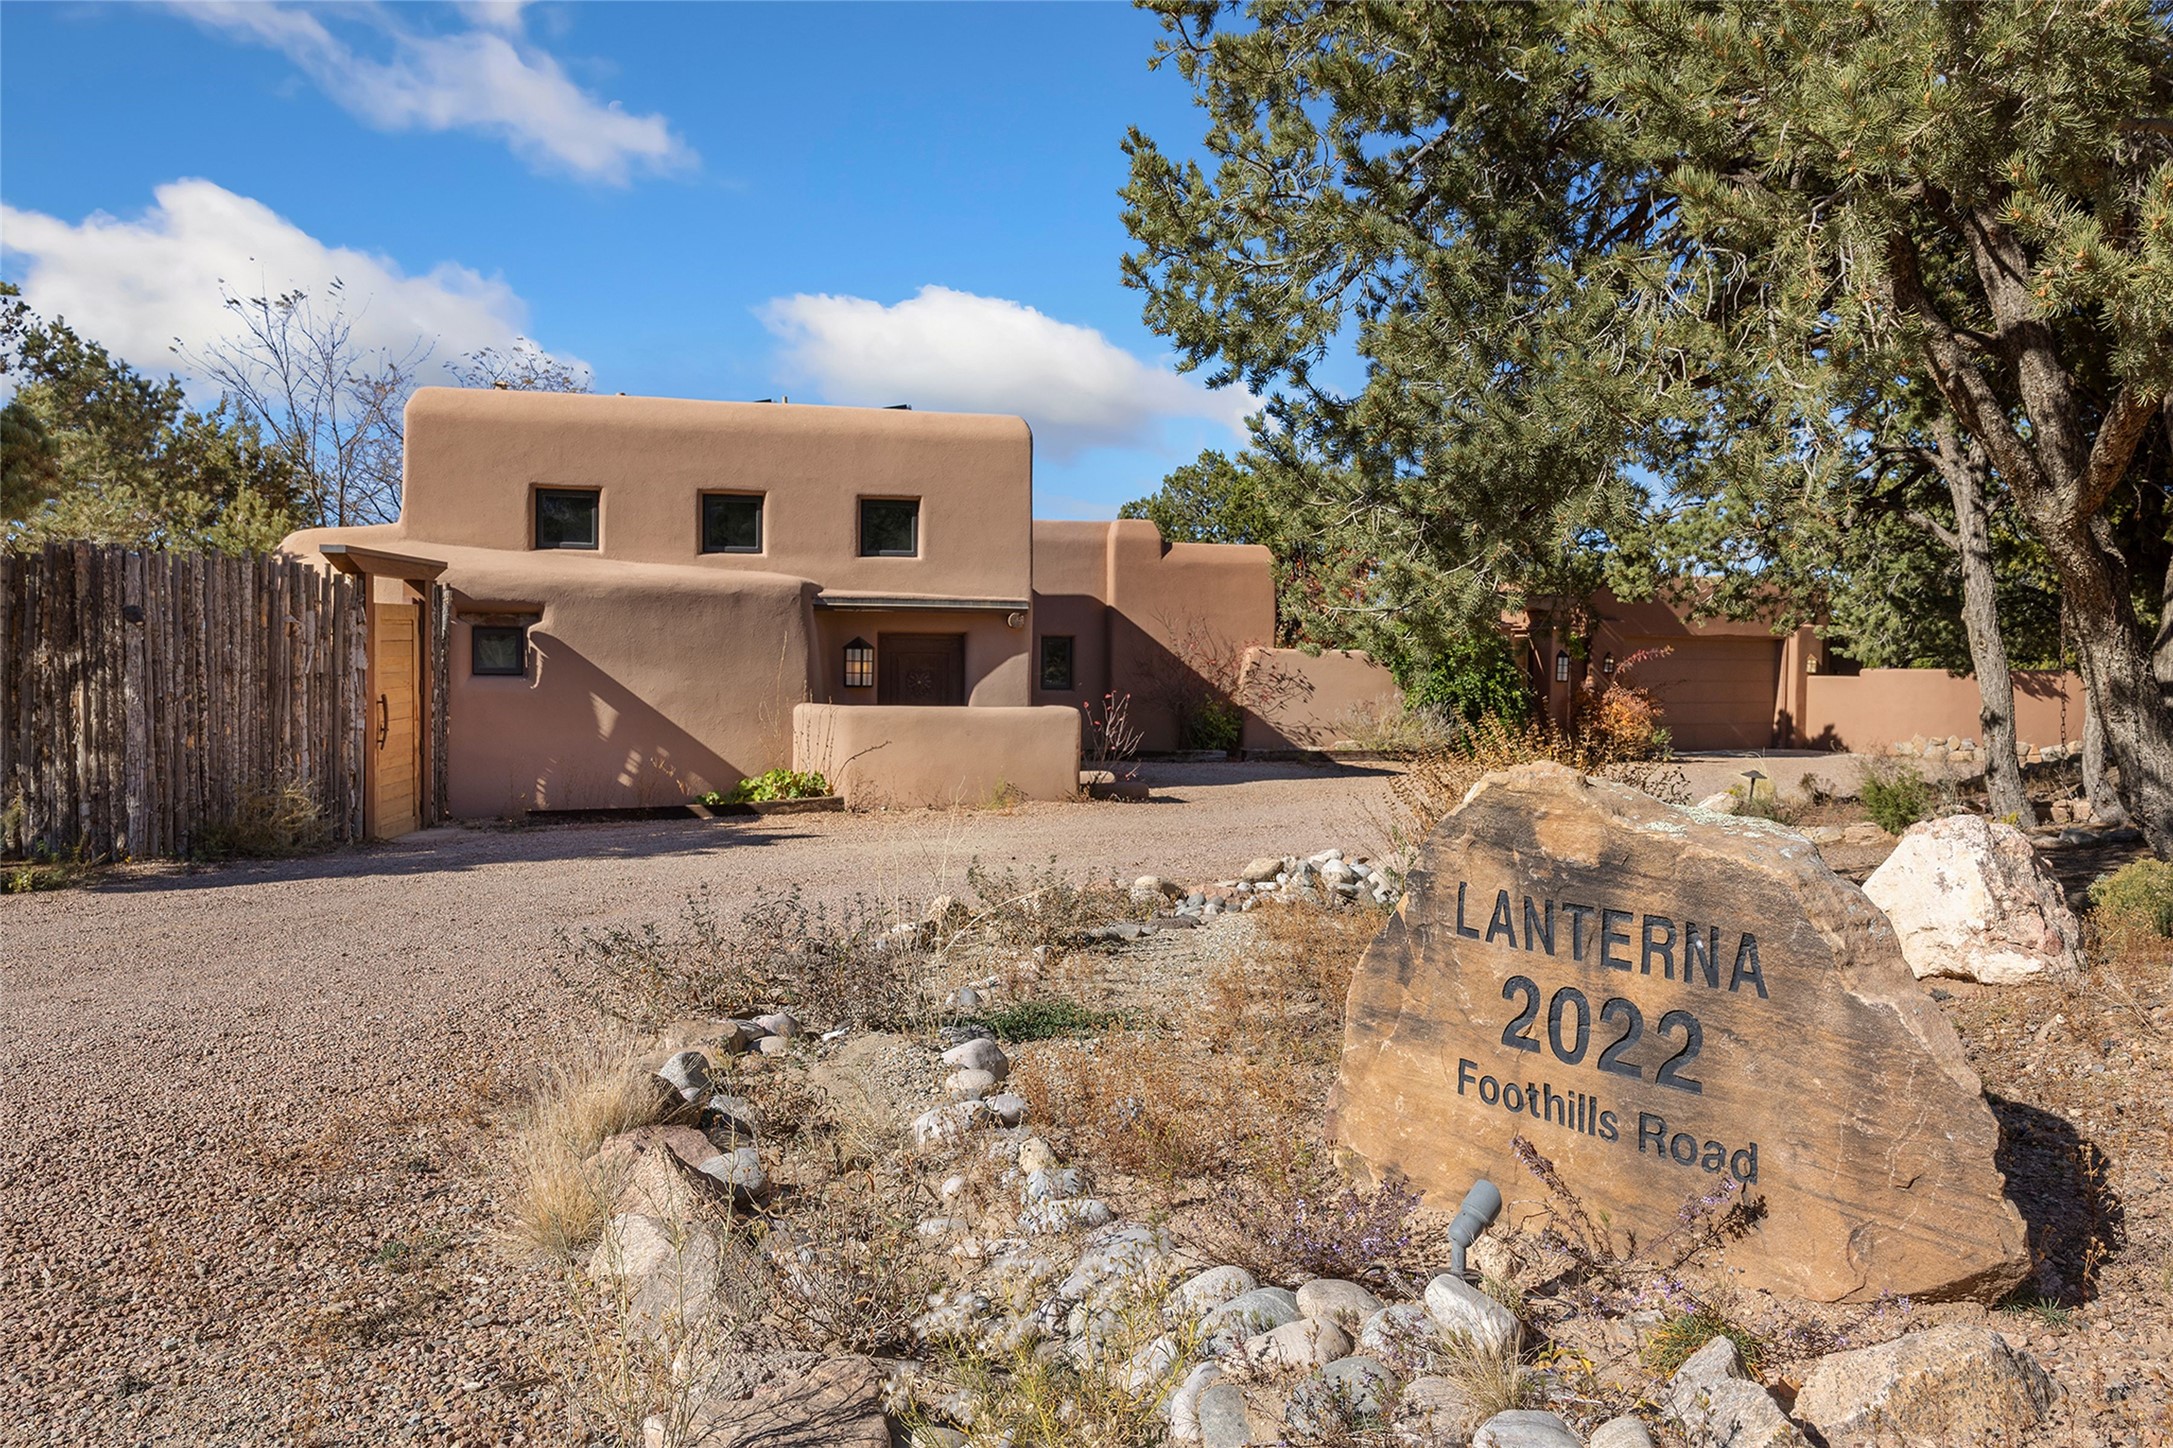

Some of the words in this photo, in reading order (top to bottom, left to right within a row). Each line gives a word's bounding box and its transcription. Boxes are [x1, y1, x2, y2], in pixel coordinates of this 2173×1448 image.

[1456, 881, 1769, 999] LANTERNA
[1501, 975, 1703, 1094] 2022
[1458, 1058, 1619, 1143] Foothills
[1638, 1111, 1758, 1185] Road
